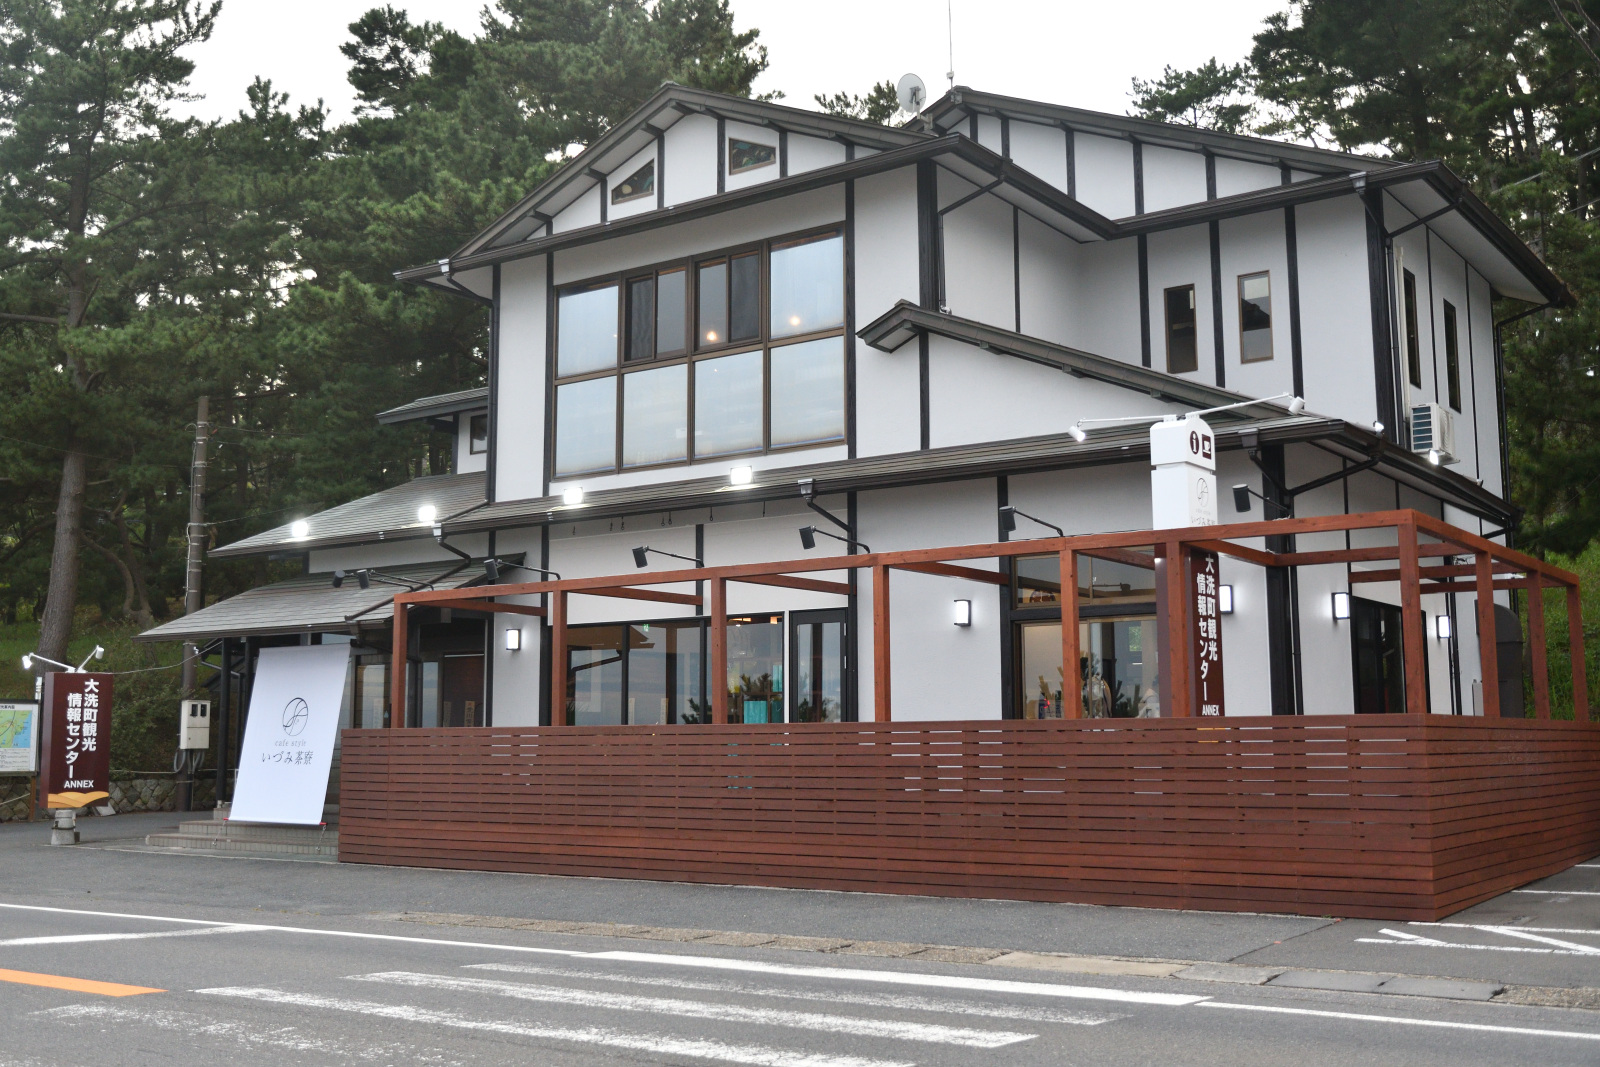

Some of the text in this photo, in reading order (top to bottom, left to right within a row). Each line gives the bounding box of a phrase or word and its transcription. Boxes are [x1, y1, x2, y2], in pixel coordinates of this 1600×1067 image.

[1197, 572, 1209, 701] 情報センター
[1205, 553, 1218, 661] 大洗町観光
[66, 693, 82, 779] 情報センター
[82, 679, 99, 752] 大洗町観光
[1202, 704, 1219, 716] ANNEX
[64, 780, 94, 788] ANNEX
[262, 750, 314, 765] いづみ茶寮
